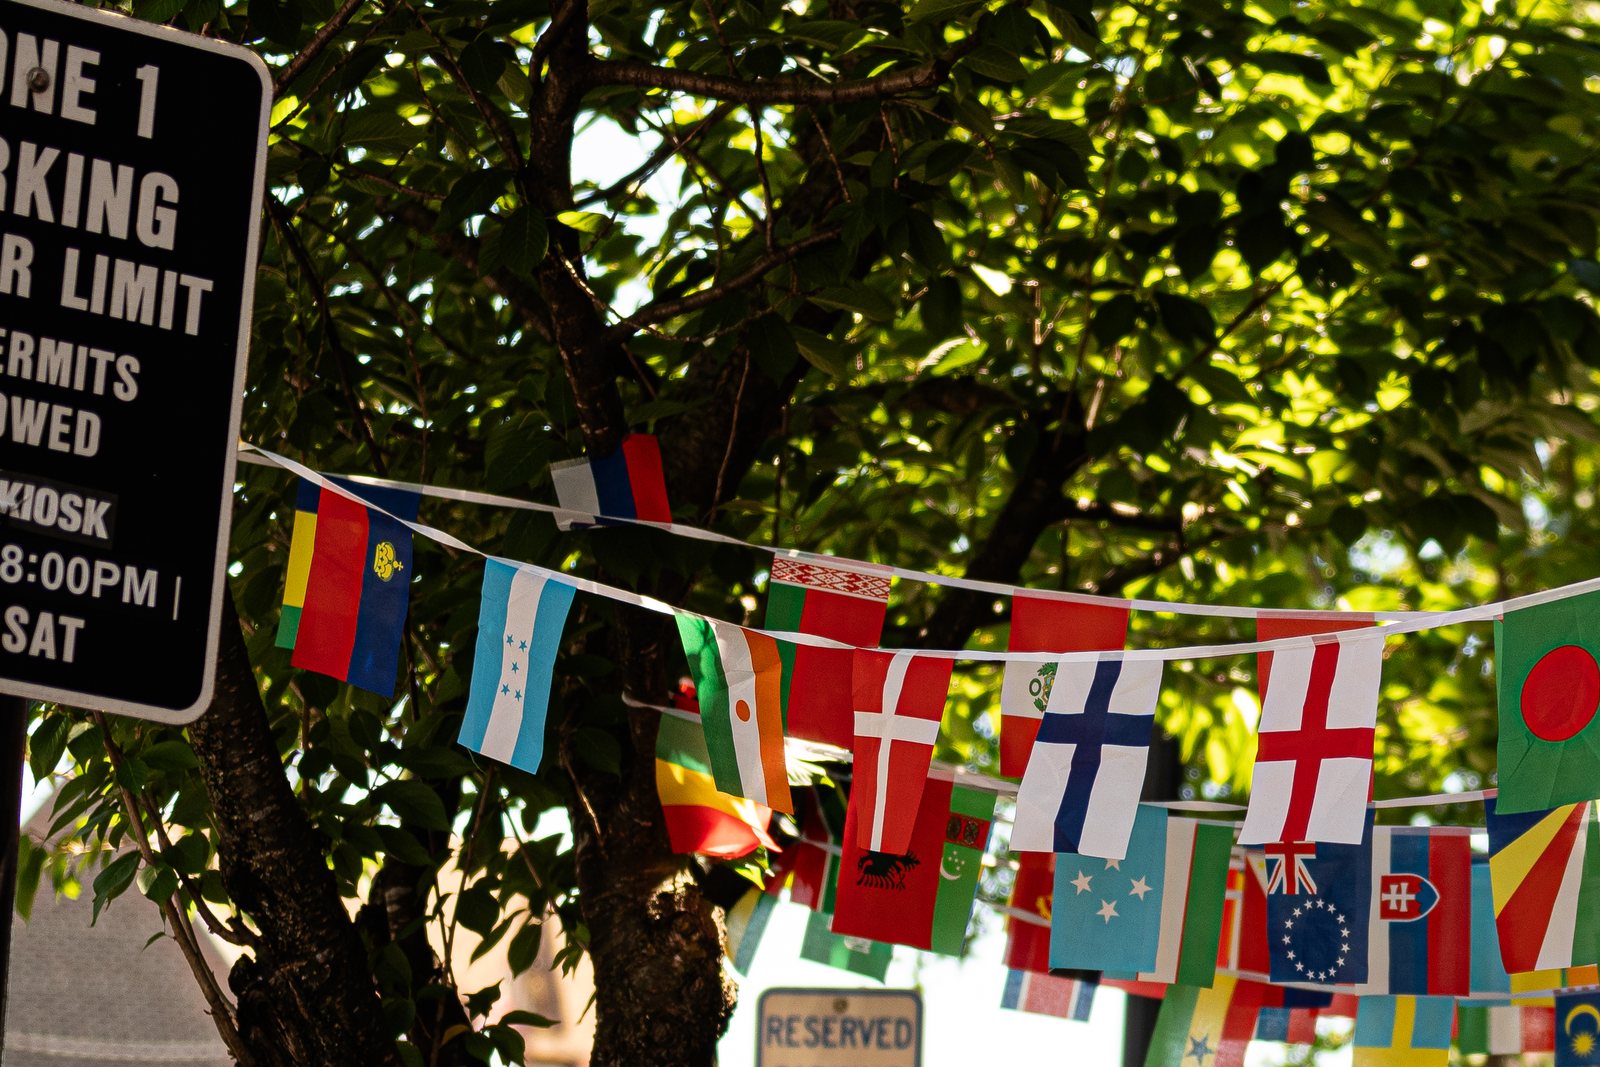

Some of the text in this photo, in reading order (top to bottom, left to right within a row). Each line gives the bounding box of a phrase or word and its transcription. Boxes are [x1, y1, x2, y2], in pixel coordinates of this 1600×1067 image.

[0, 27, 160, 139] NE 1
[60, 247, 214, 336] LIMIT
[0, 478, 112, 540] KIOSK
[0, 544, 159, 608] 8:00PM
[1, 605, 86, 664] SAT
[766, 1014, 914, 1050] RESERVED
